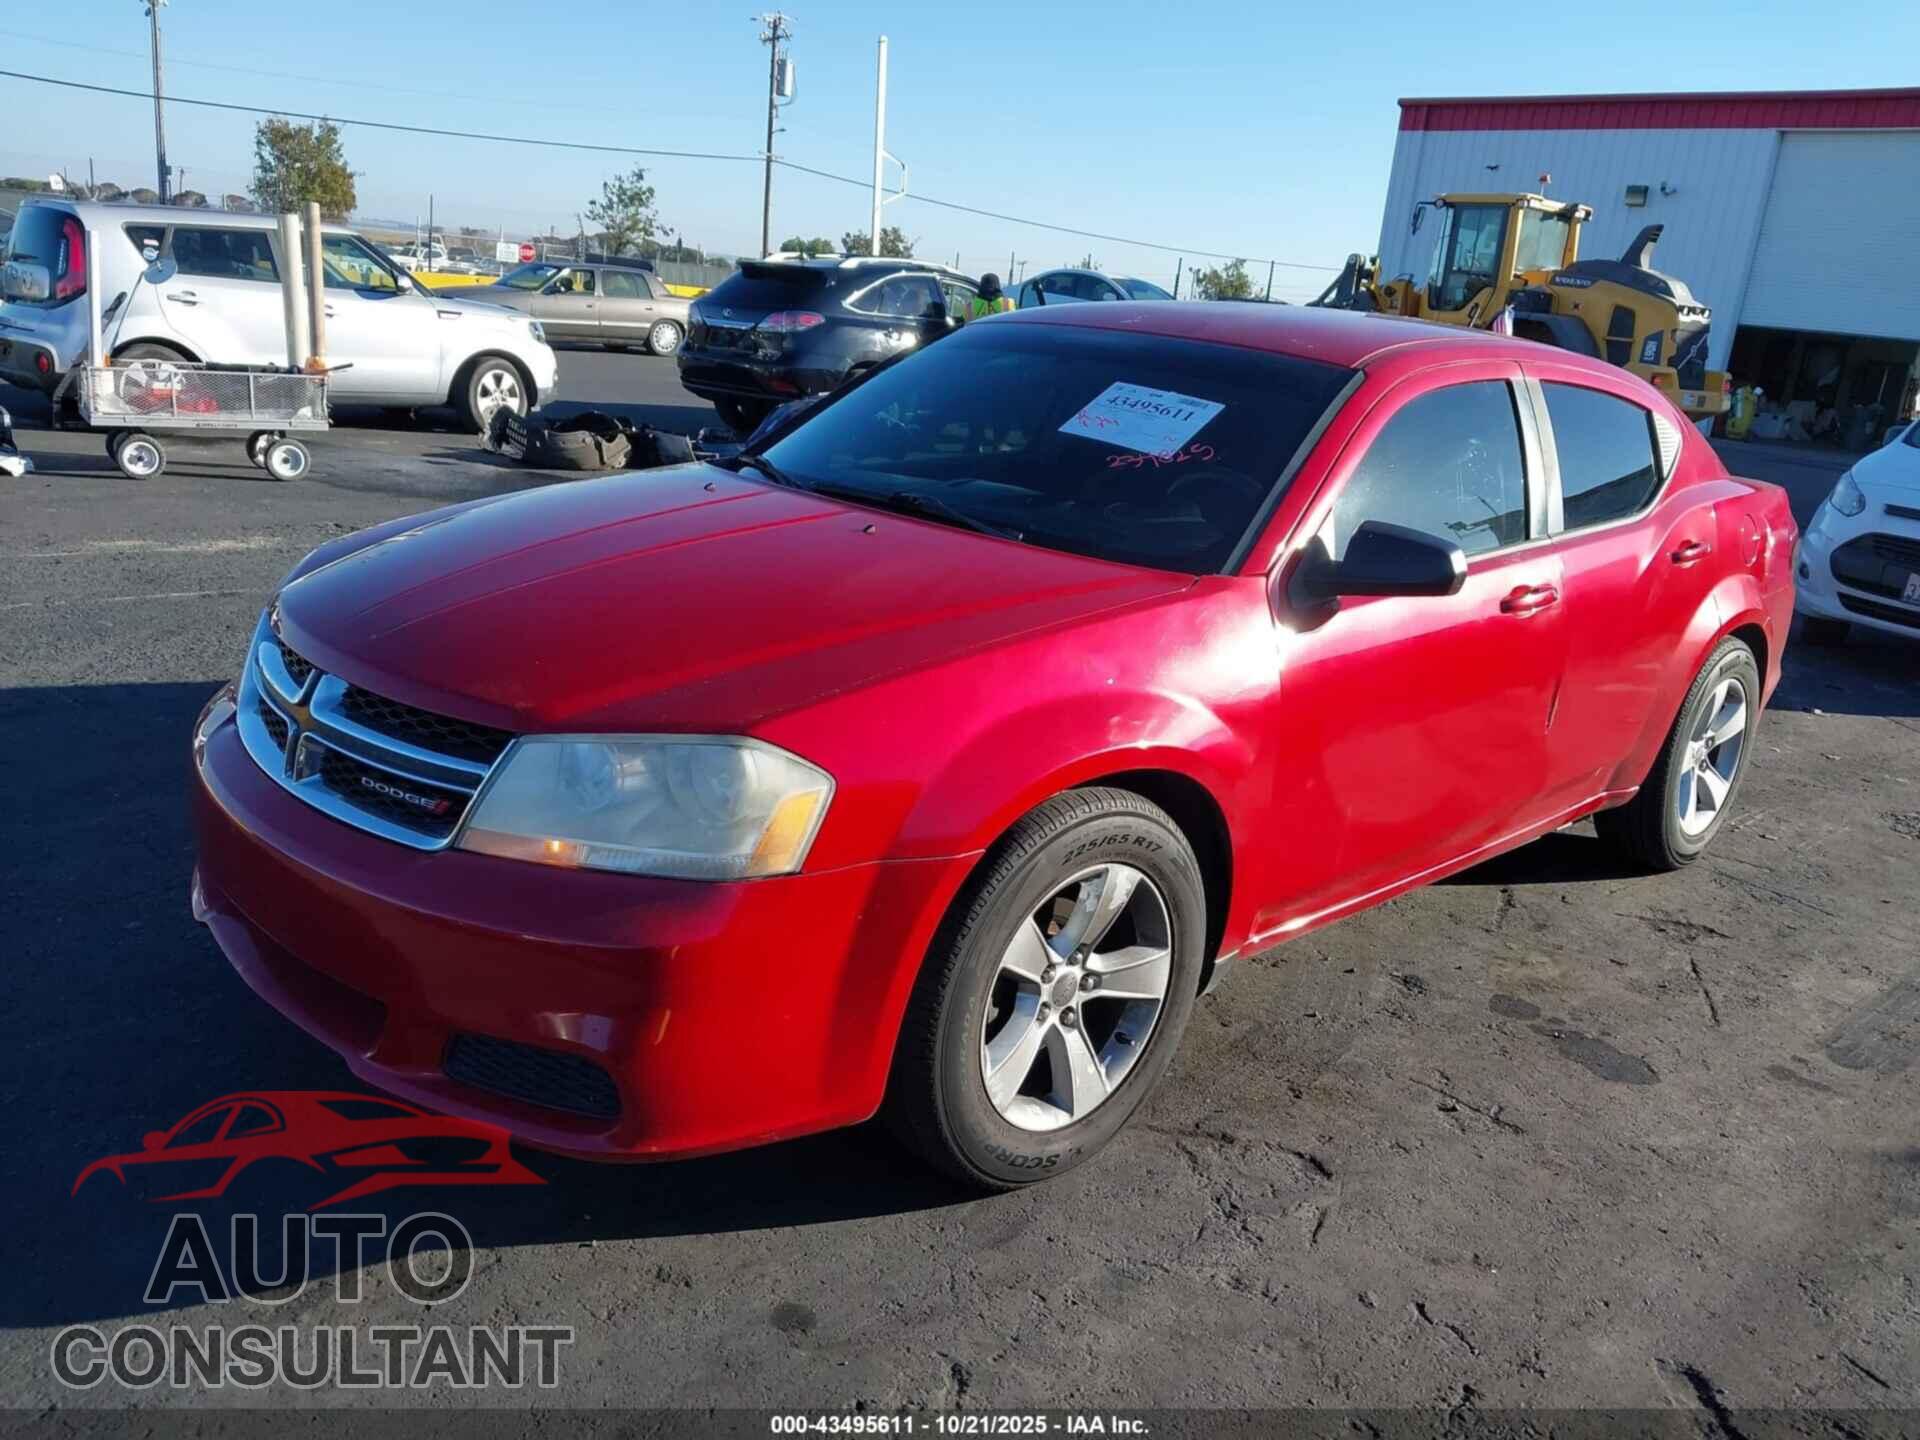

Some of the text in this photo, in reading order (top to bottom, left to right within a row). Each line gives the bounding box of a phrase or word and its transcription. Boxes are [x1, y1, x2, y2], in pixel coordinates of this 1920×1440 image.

[1554, 275, 1592, 287] VOLVO
[1105, 393, 1196, 422] 43495611
[361, 776, 434, 809] DODGE
[1061, 833, 1163, 866] 225/65 R17
